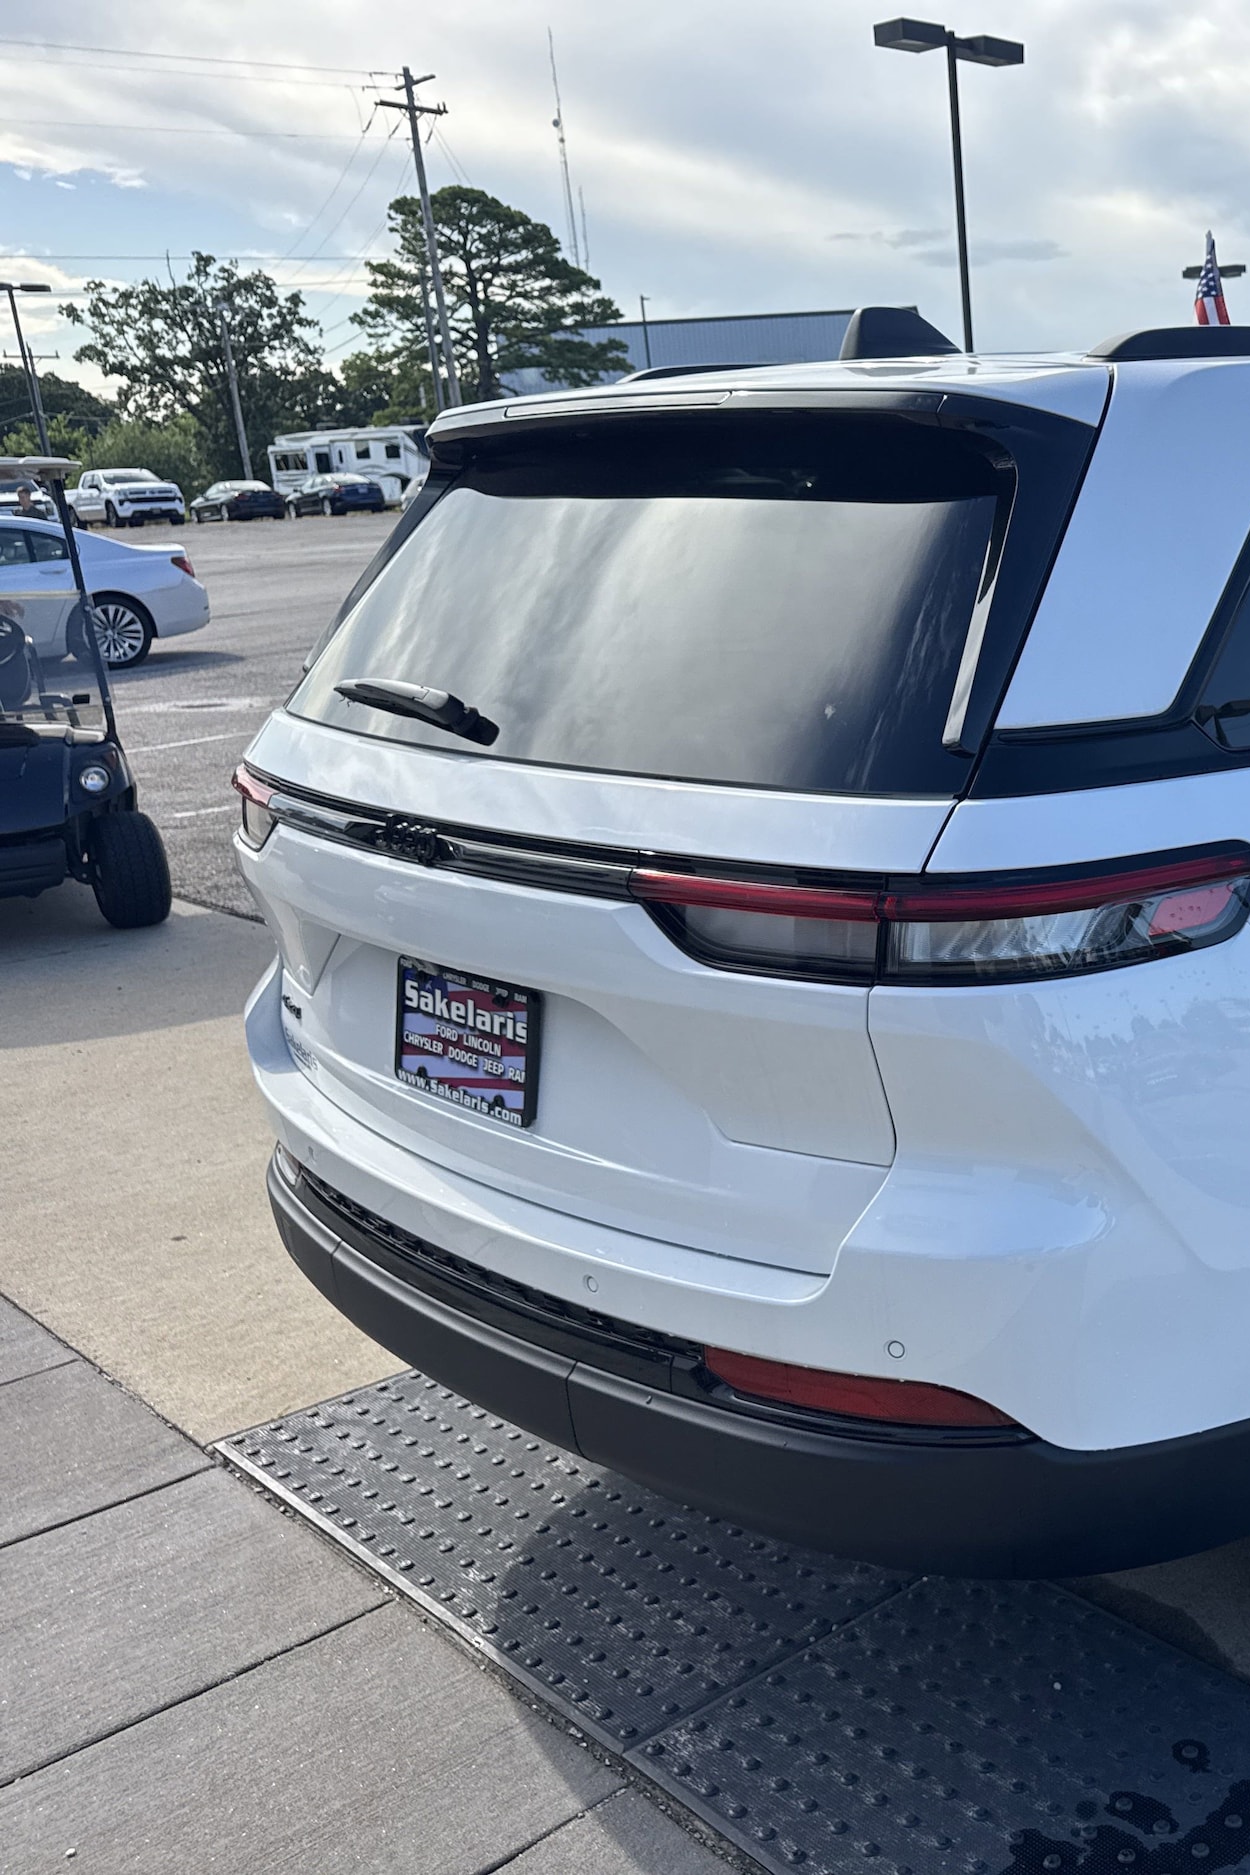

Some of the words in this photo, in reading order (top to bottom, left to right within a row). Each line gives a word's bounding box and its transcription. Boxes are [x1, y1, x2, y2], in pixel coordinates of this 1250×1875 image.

[405, 979, 528, 1044] Sakelaris
[404, 1030, 444, 1054] CHRYSLER
[448, 1046, 478, 1067] DODGE
[483, 1058, 505, 1076] JEEP
[436, 1024, 458, 1041] FORD
[463, 1035, 502, 1056] LINCOLN
[398, 1069, 522, 1126] www.Sakelaris.com
